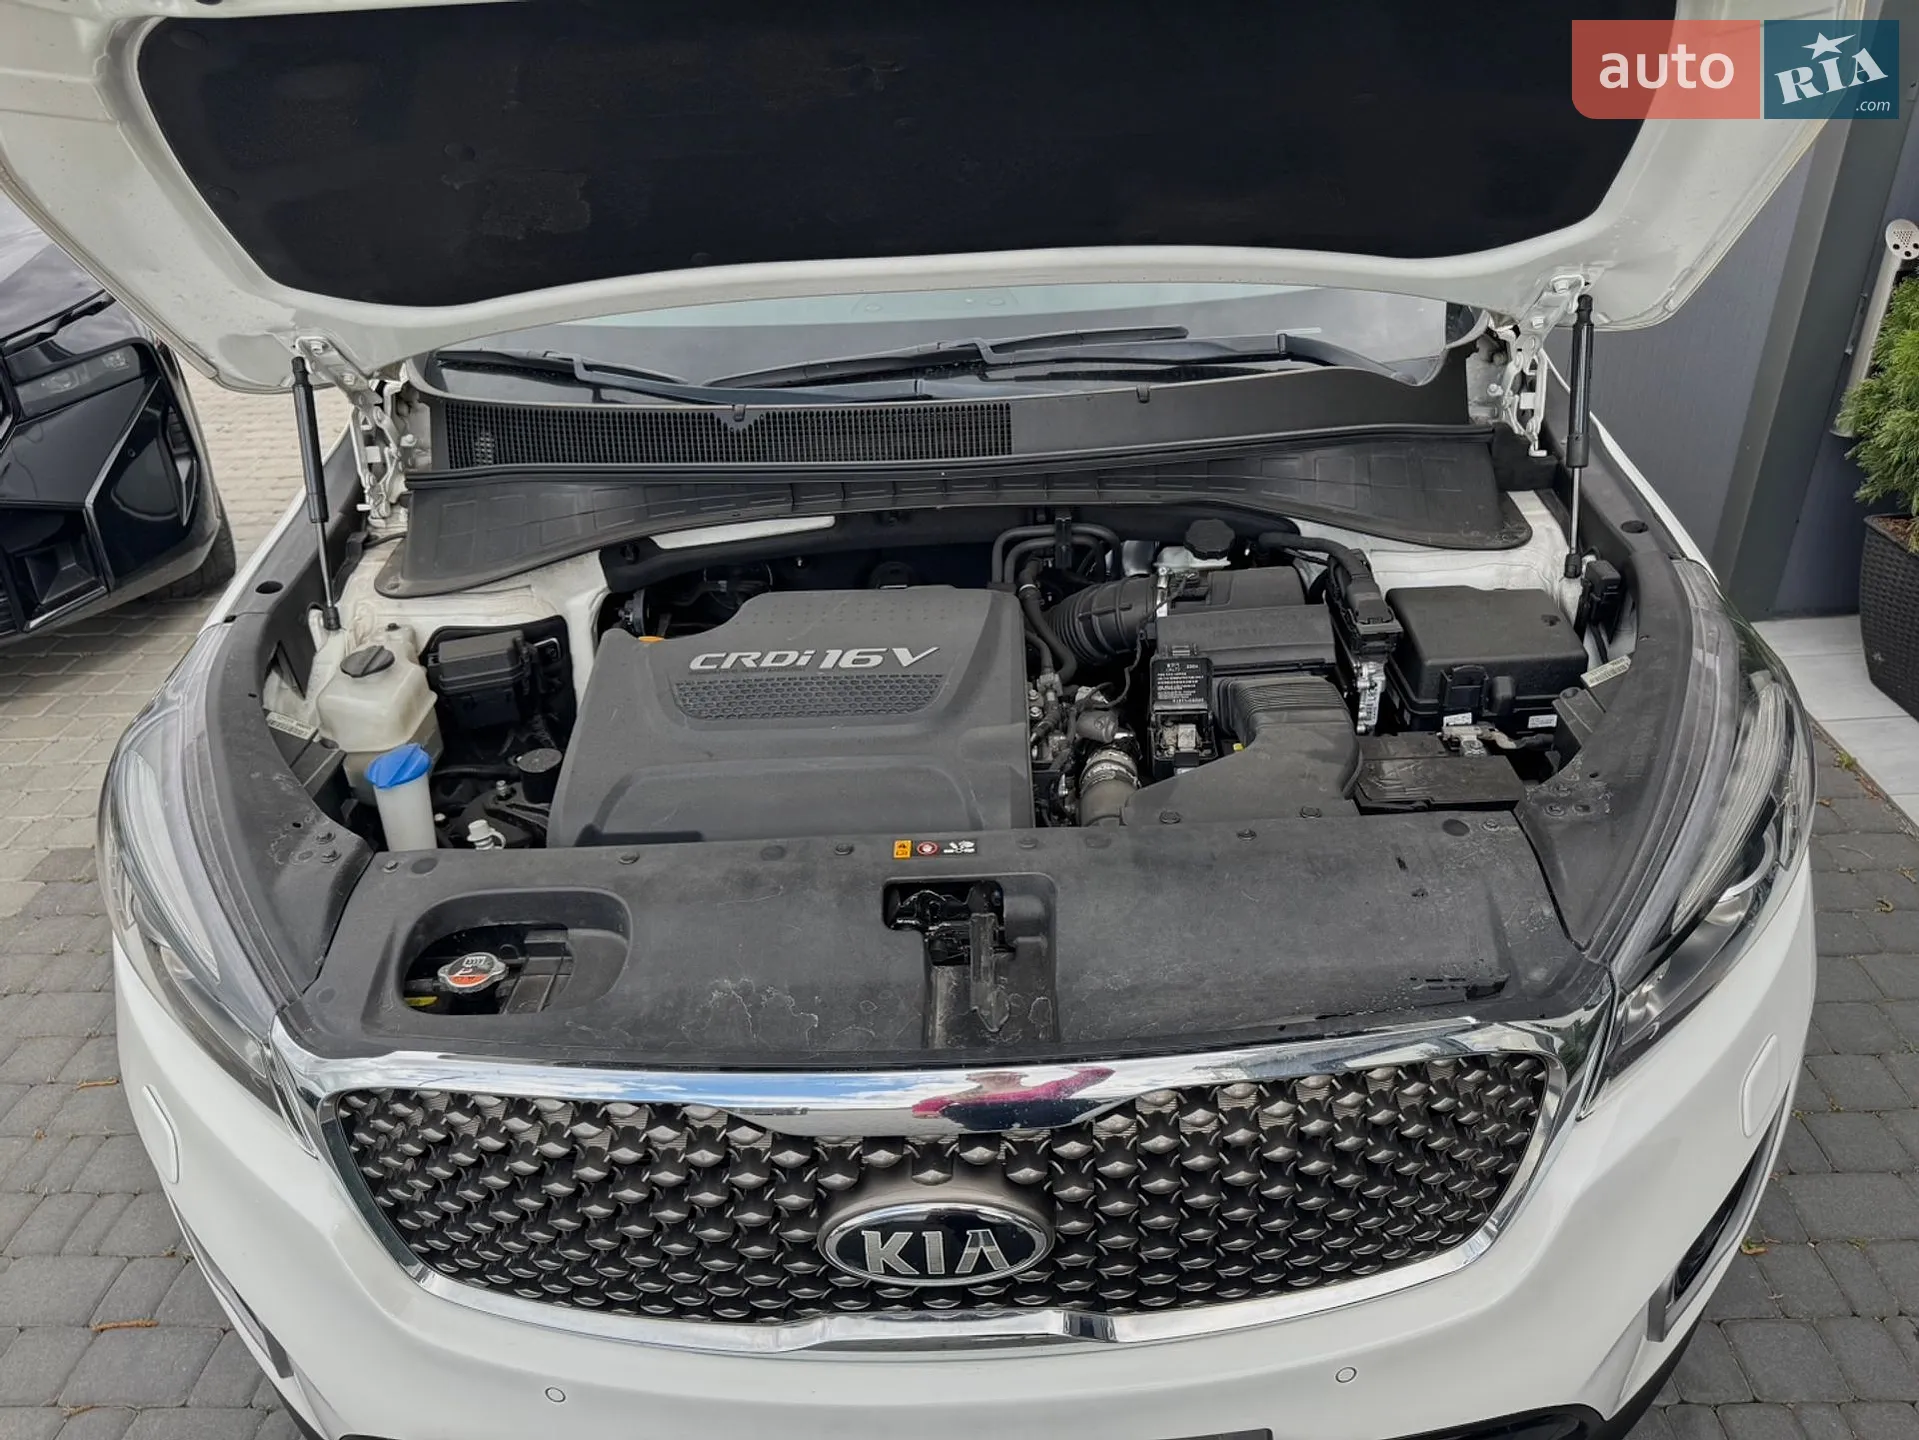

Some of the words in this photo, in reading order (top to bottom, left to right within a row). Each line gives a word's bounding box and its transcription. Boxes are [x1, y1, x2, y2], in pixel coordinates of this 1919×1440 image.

[689, 650, 816, 670] CRDi
[819, 647, 940, 669] 16V
[861, 1229, 1011, 1275] KIA
